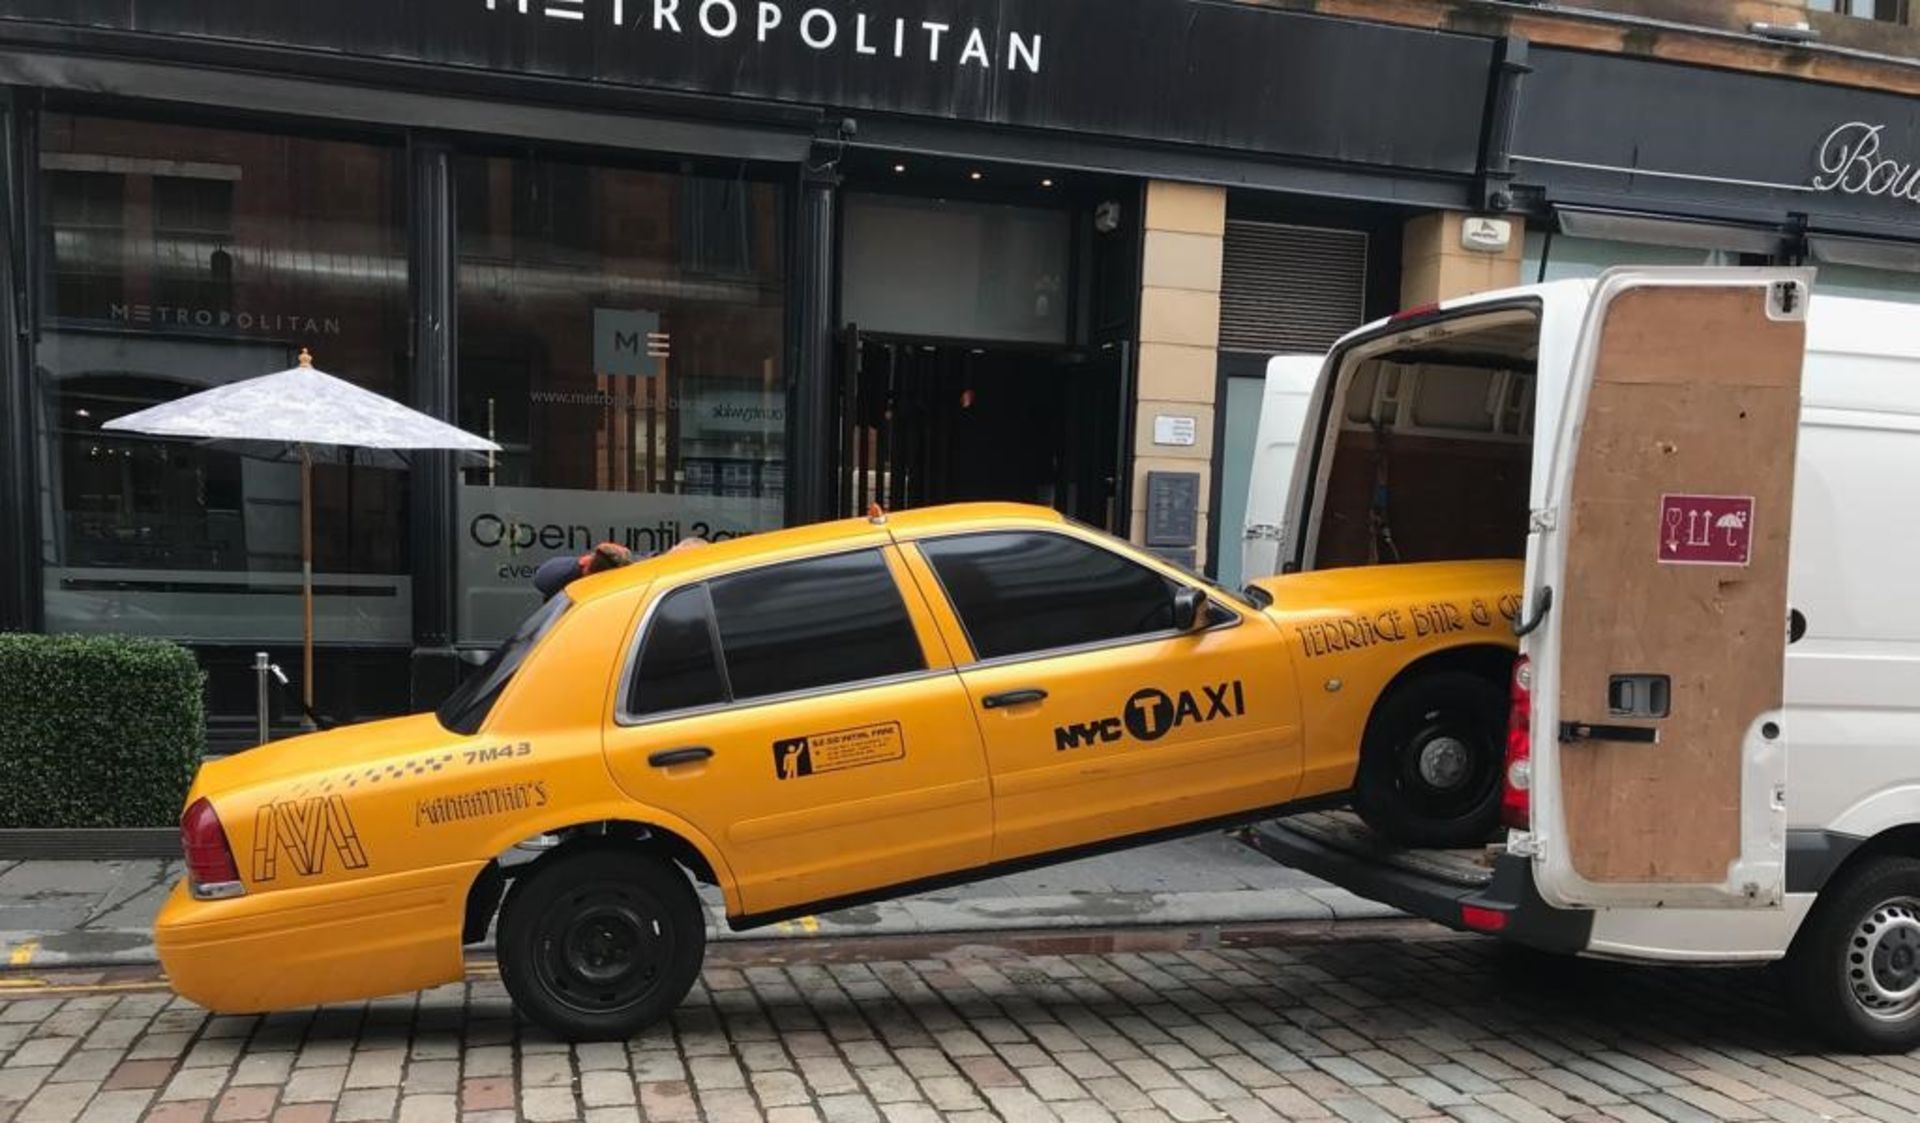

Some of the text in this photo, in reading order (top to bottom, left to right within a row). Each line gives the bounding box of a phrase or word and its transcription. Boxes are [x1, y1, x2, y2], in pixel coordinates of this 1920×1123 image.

[486, 0, 1041, 73] ETROPOLITAN
[110, 303, 341, 334] METROPOLITAN
[470, 513, 592, 556] Open
[609, 521, 680, 552] until
[1295, 608, 1405, 658] TERRACE
[1409, 601, 1466, 638] BAR
[1053, 680, 1246, 751] NYC TAXI
[462, 742, 532, 765] 7M43
